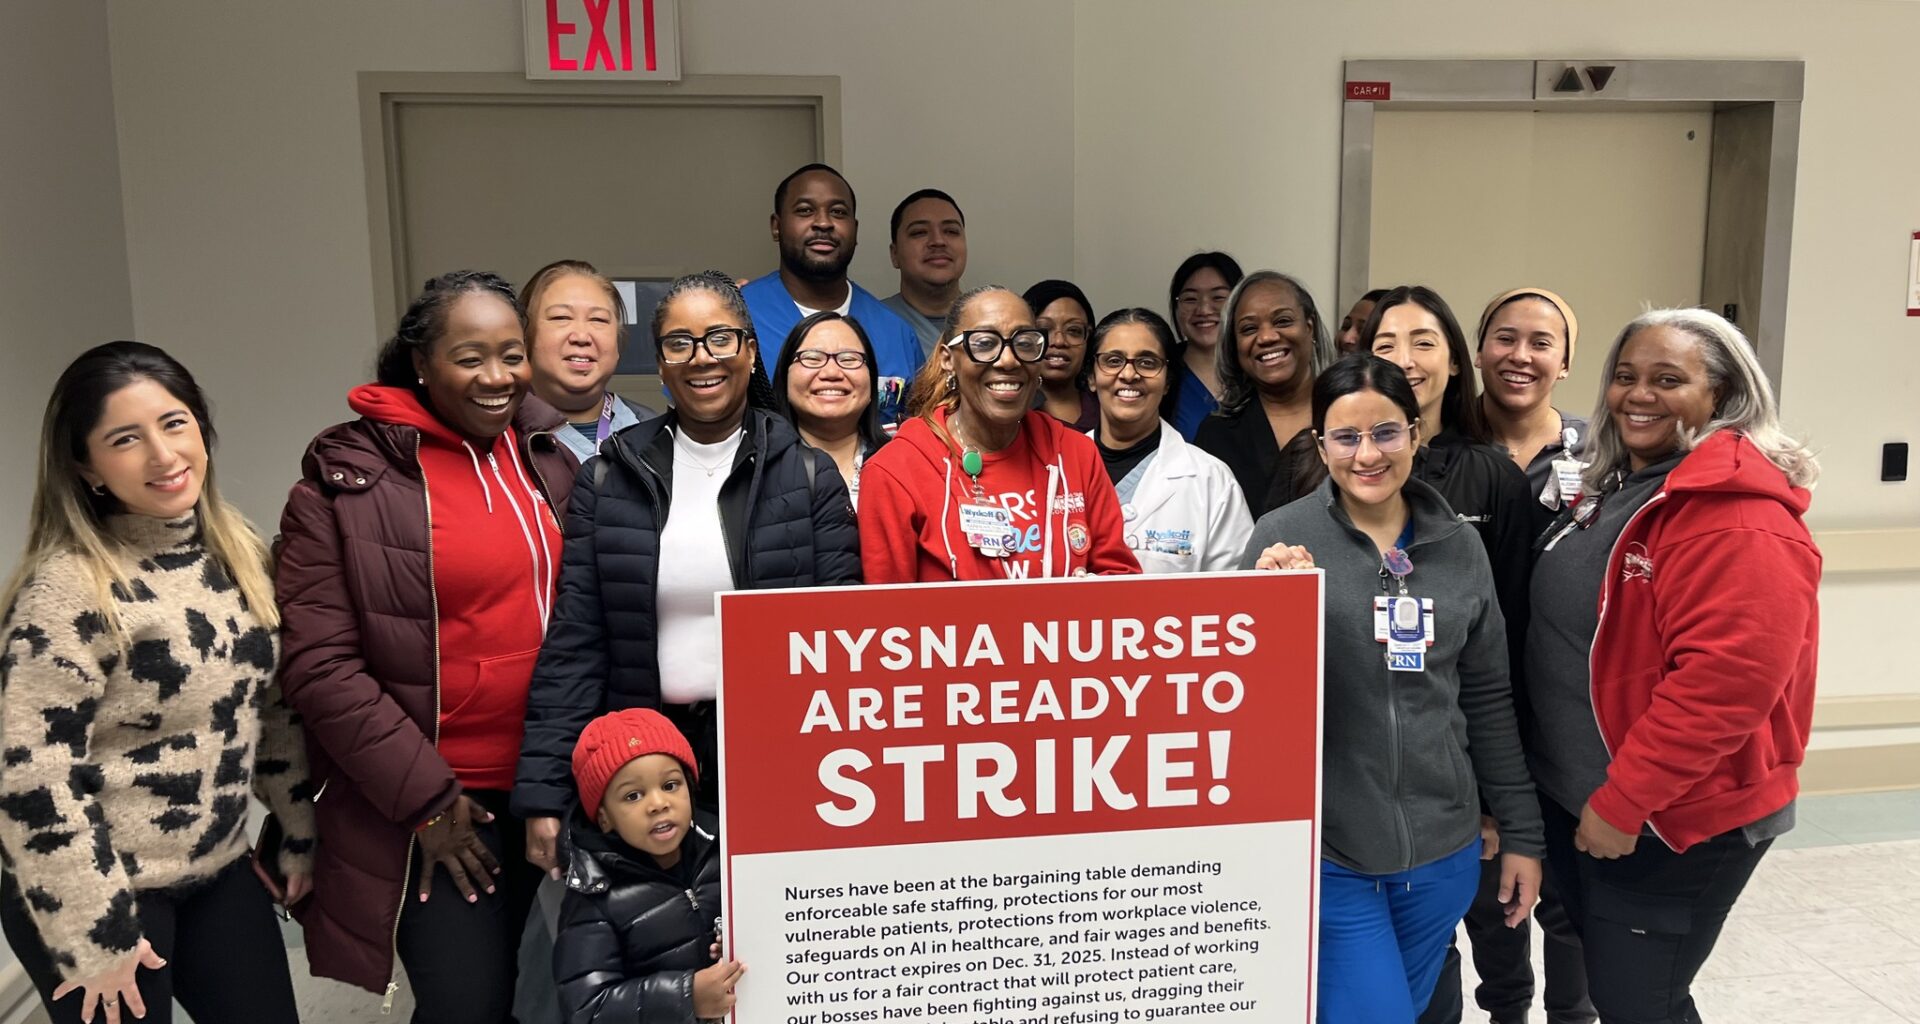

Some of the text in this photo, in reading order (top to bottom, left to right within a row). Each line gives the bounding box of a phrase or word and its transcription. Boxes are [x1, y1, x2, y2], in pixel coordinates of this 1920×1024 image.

[546, 0, 656, 71] EXIT
[982, 537, 1000, 546] RN
[789, 614, 1257, 674] NYSNA NURSES
[1395, 655, 1417, 667] RN
[799, 671, 1245, 733] ARE READY TO
[815, 730, 1232, 827] STRIKE!
[785, 860, 1221, 901] Nurses have been at the bargaining table demanding
[785, 882, 1203, 922] enforceable safe staffing, protections for our most
[785, 900, 1261, 943] vulnerable patients, protections from workplace violence,
[786, 918, 1270, 965] safeguards on AI in healthcare, and fair wages and benefits.
[786, 939, 1259, 985] Our contract expires on Dec. 31, 2025. Instead of working
[786, 962, 1236, 1006] with us for a fair contract that will protect patient care,
[787, 979, 1244, 1024] our bosses have been fighting against us, dragging their
[1054, 1010, 1119, 1024] refusing
[1124, 1008, 1140, 1020] to
[1145, 1002, 1225, 1022] guarantee
[1230, 1000, 1256, 1011] our
